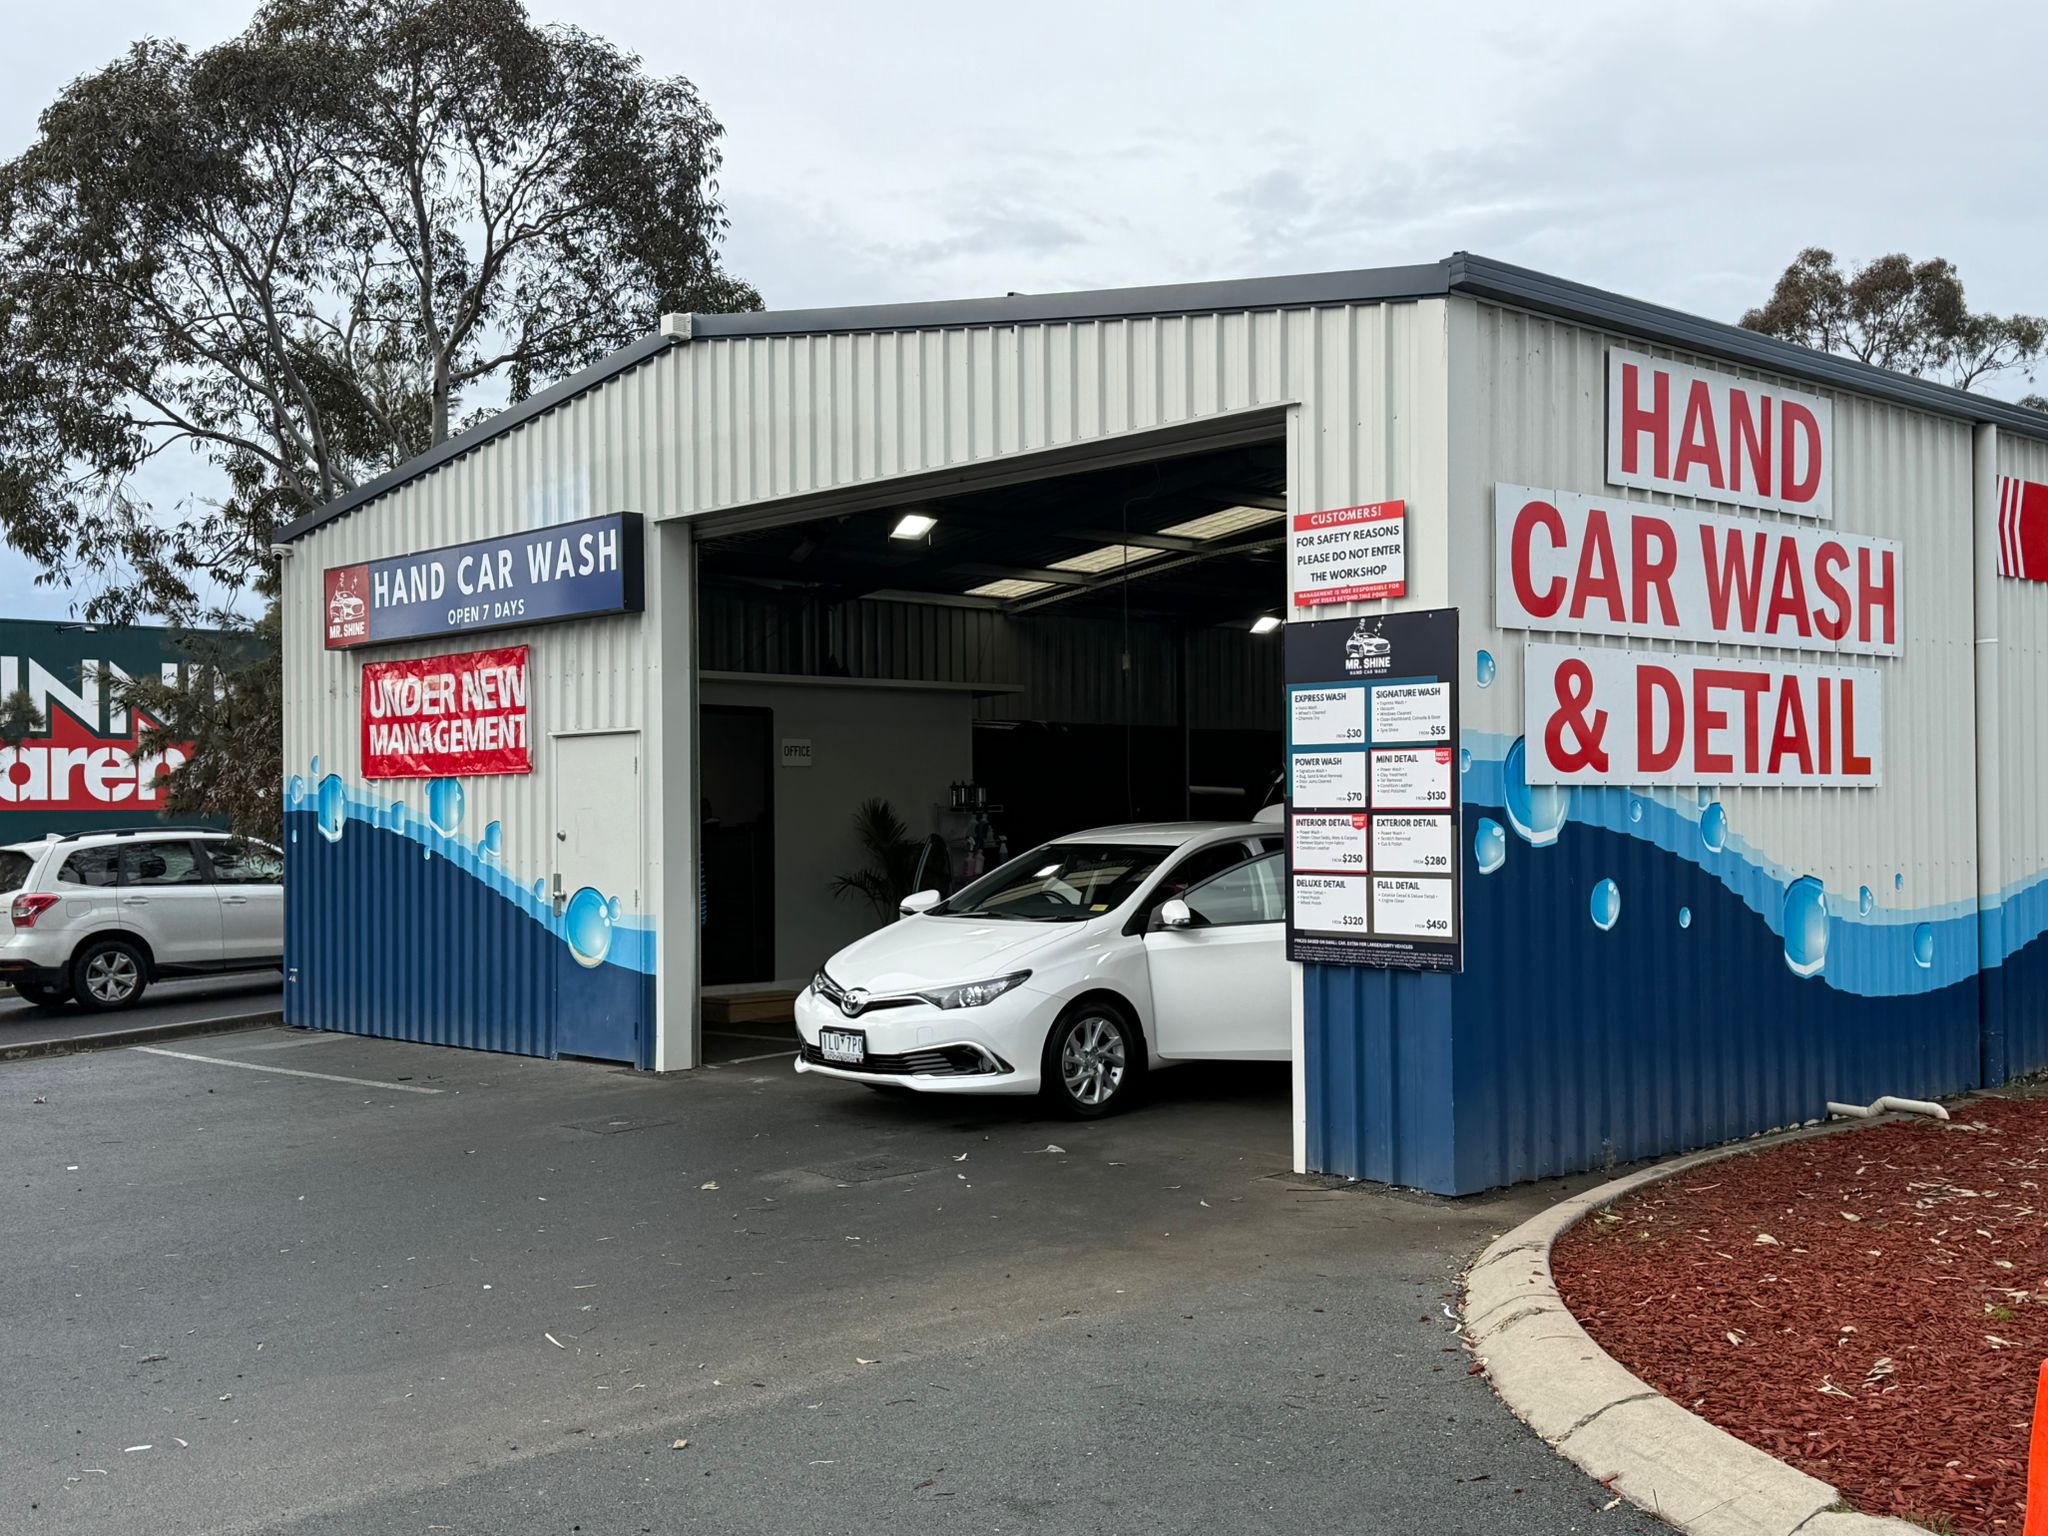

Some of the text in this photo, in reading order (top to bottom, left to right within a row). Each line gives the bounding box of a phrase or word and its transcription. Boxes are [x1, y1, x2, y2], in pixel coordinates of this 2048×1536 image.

[1621, 363, 1822, 503] HAND
[1311, 506, 1382, 525] CUSTOMERS!
[1296, 525, 1400, 547] FOR SAFETY REASONS
[1297, 544, 1401, 565] PLEASE DO NOT ENTER
[374, 528, 617, 608] HAND CAR WASH
[1310, 564, 1387, 582] THE WORKSHOP
[1511, 500, 1895, 644] CAR WASH
[1298, 590, 1333, 599] MANAGEMENT
[1353, 584, 1388, 593] RESPONSIBLE
[448, 599, 525, 625] OPEN 7 DAYS
[329, 621, 365, 639] MR. SHINE
[1345, 656, 1391, 670] MR. SHINE
[370, 664, 526, 718] UNDER NEW
[1376, 687, 1441, 699] SIGNATURE WASH
[1295, 692, 1346, 703] EXPRESS WASH
[1544, 658, 1872, 775] & DETAIL
[369, 713, 526, 756] MANAGEMENT
[1347, 728, 1362, 739] $30
[1430, 725, 1446, 736] $55
[784, 745, 811, 757] OFFICE
[1295, 758, 1320, 766] POWER
[1376, 755, 1419, 763] MINI DETAIL
[1347, 792, 1362, 802] $70
[1427, 790, 1447, 801] $130
[1296, 819, 1327, 827] INTERIOR
[1328, 819, 1351, 827] DETAIL
[1376, 819, 1438, 827] EXTERIOR DETAIL
[1342, 853, 1363, 864] $250
[1424, 855, 1447, 866] $280
[1296, 879, 1346, 888] DELUXE DETAIL
[1377, 881, 1420, 890] FULL DETAIL
[1343, 915, 1364, 926] $320
[1426, 918, 1448, 930] $450
